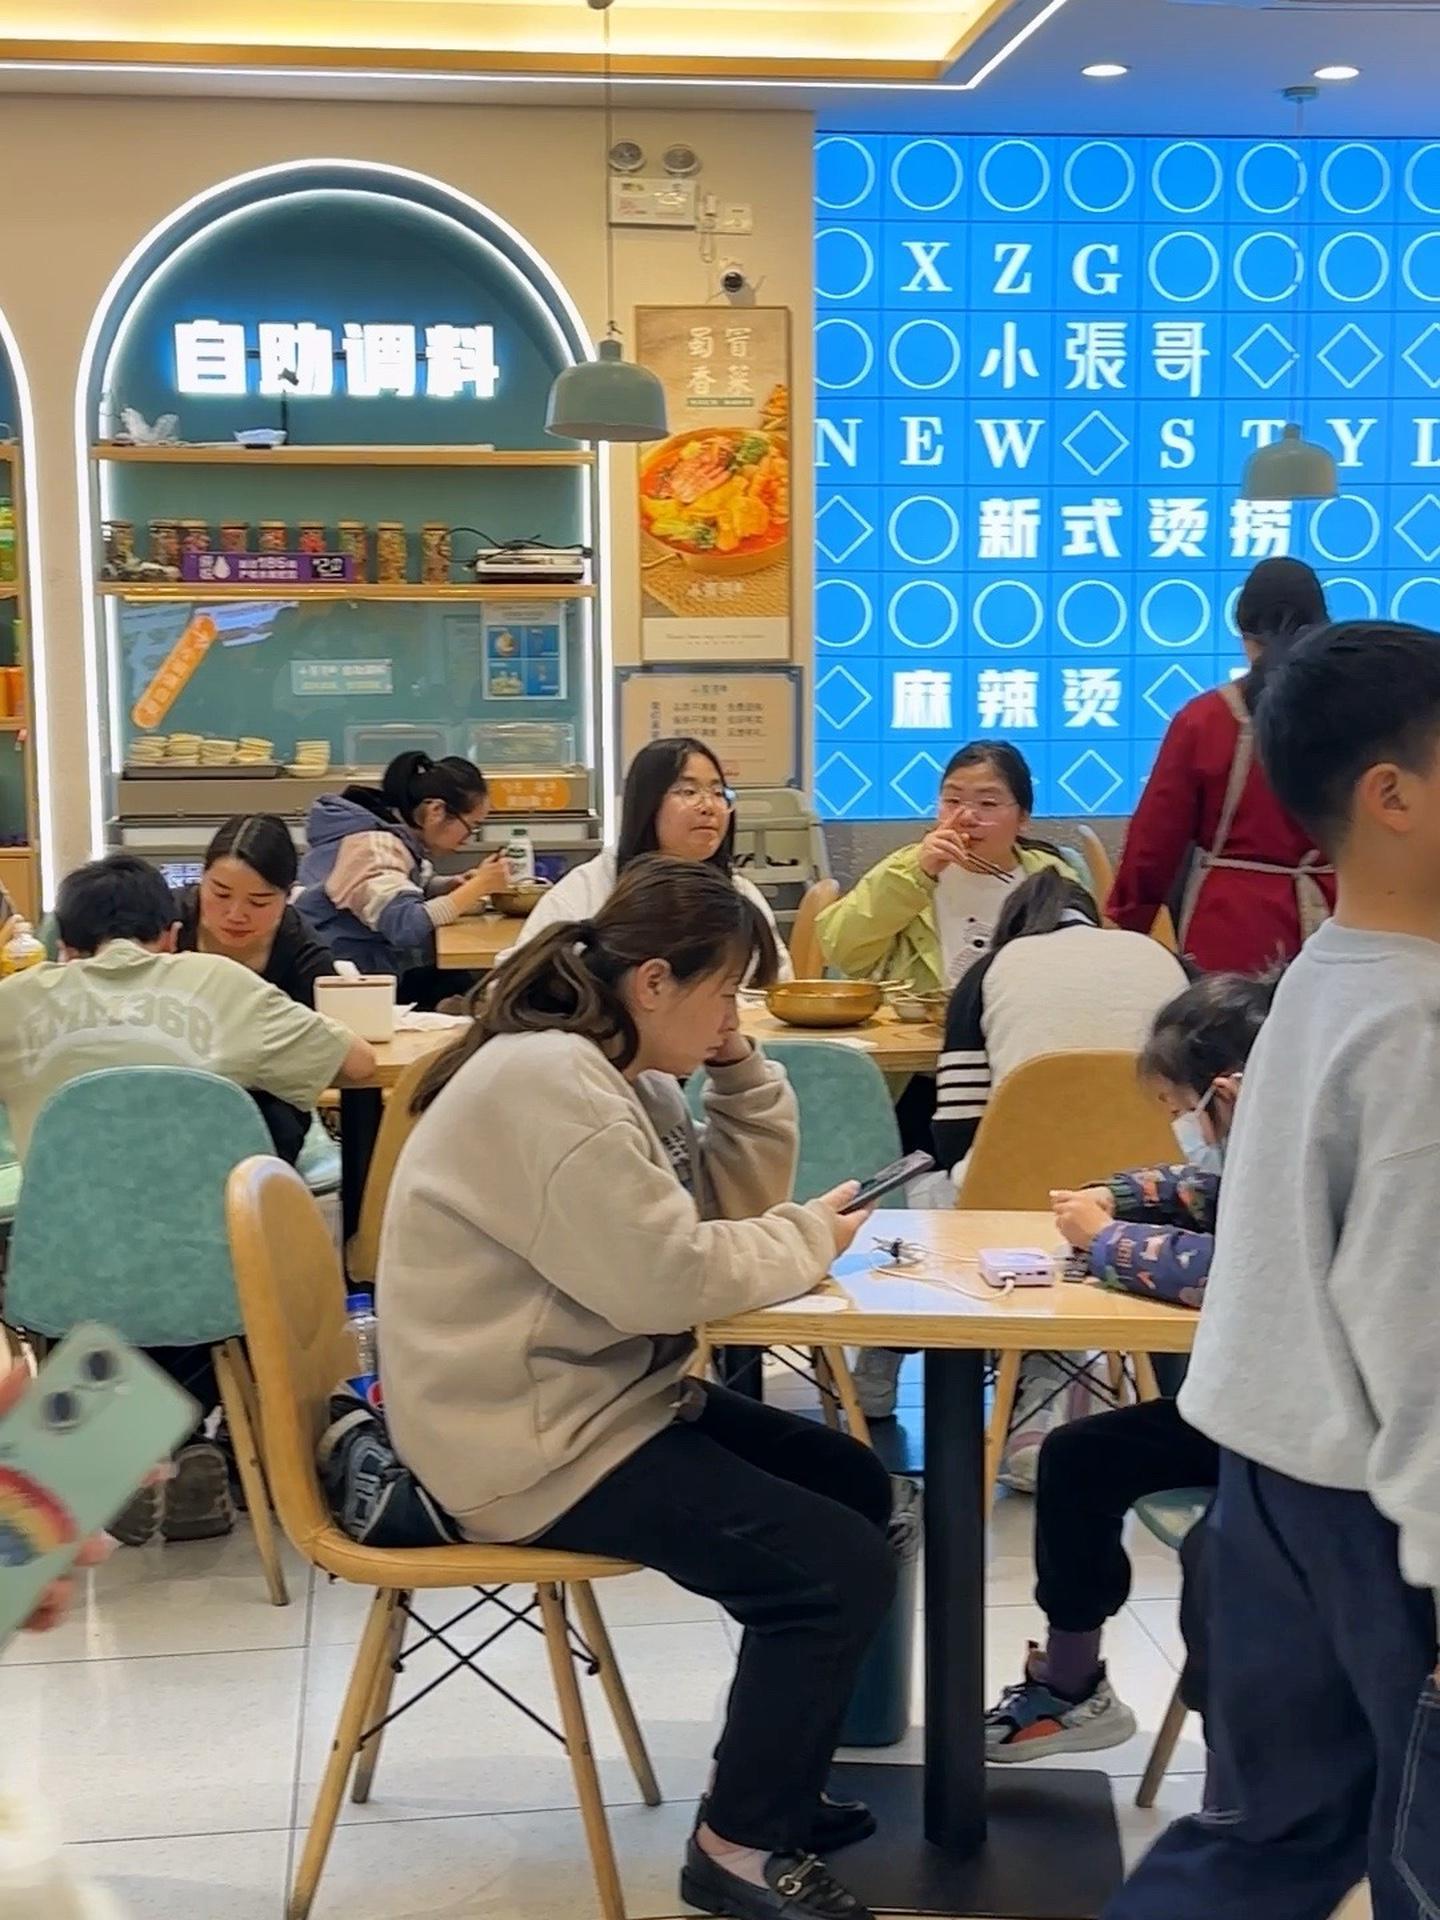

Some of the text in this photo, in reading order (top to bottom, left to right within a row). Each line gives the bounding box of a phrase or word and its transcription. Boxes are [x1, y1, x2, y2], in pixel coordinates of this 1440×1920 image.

[900, 240, 1122, 295] XZG
[175, 319, 500, 397] 自助调料
[979, 320, 1209, 397] 小張哥
[813, 416, 1045, 469] NEW
[977, 497, 1292, 558] 新式烫捞
[890, 668, 1122, 729] 麻辣烫
